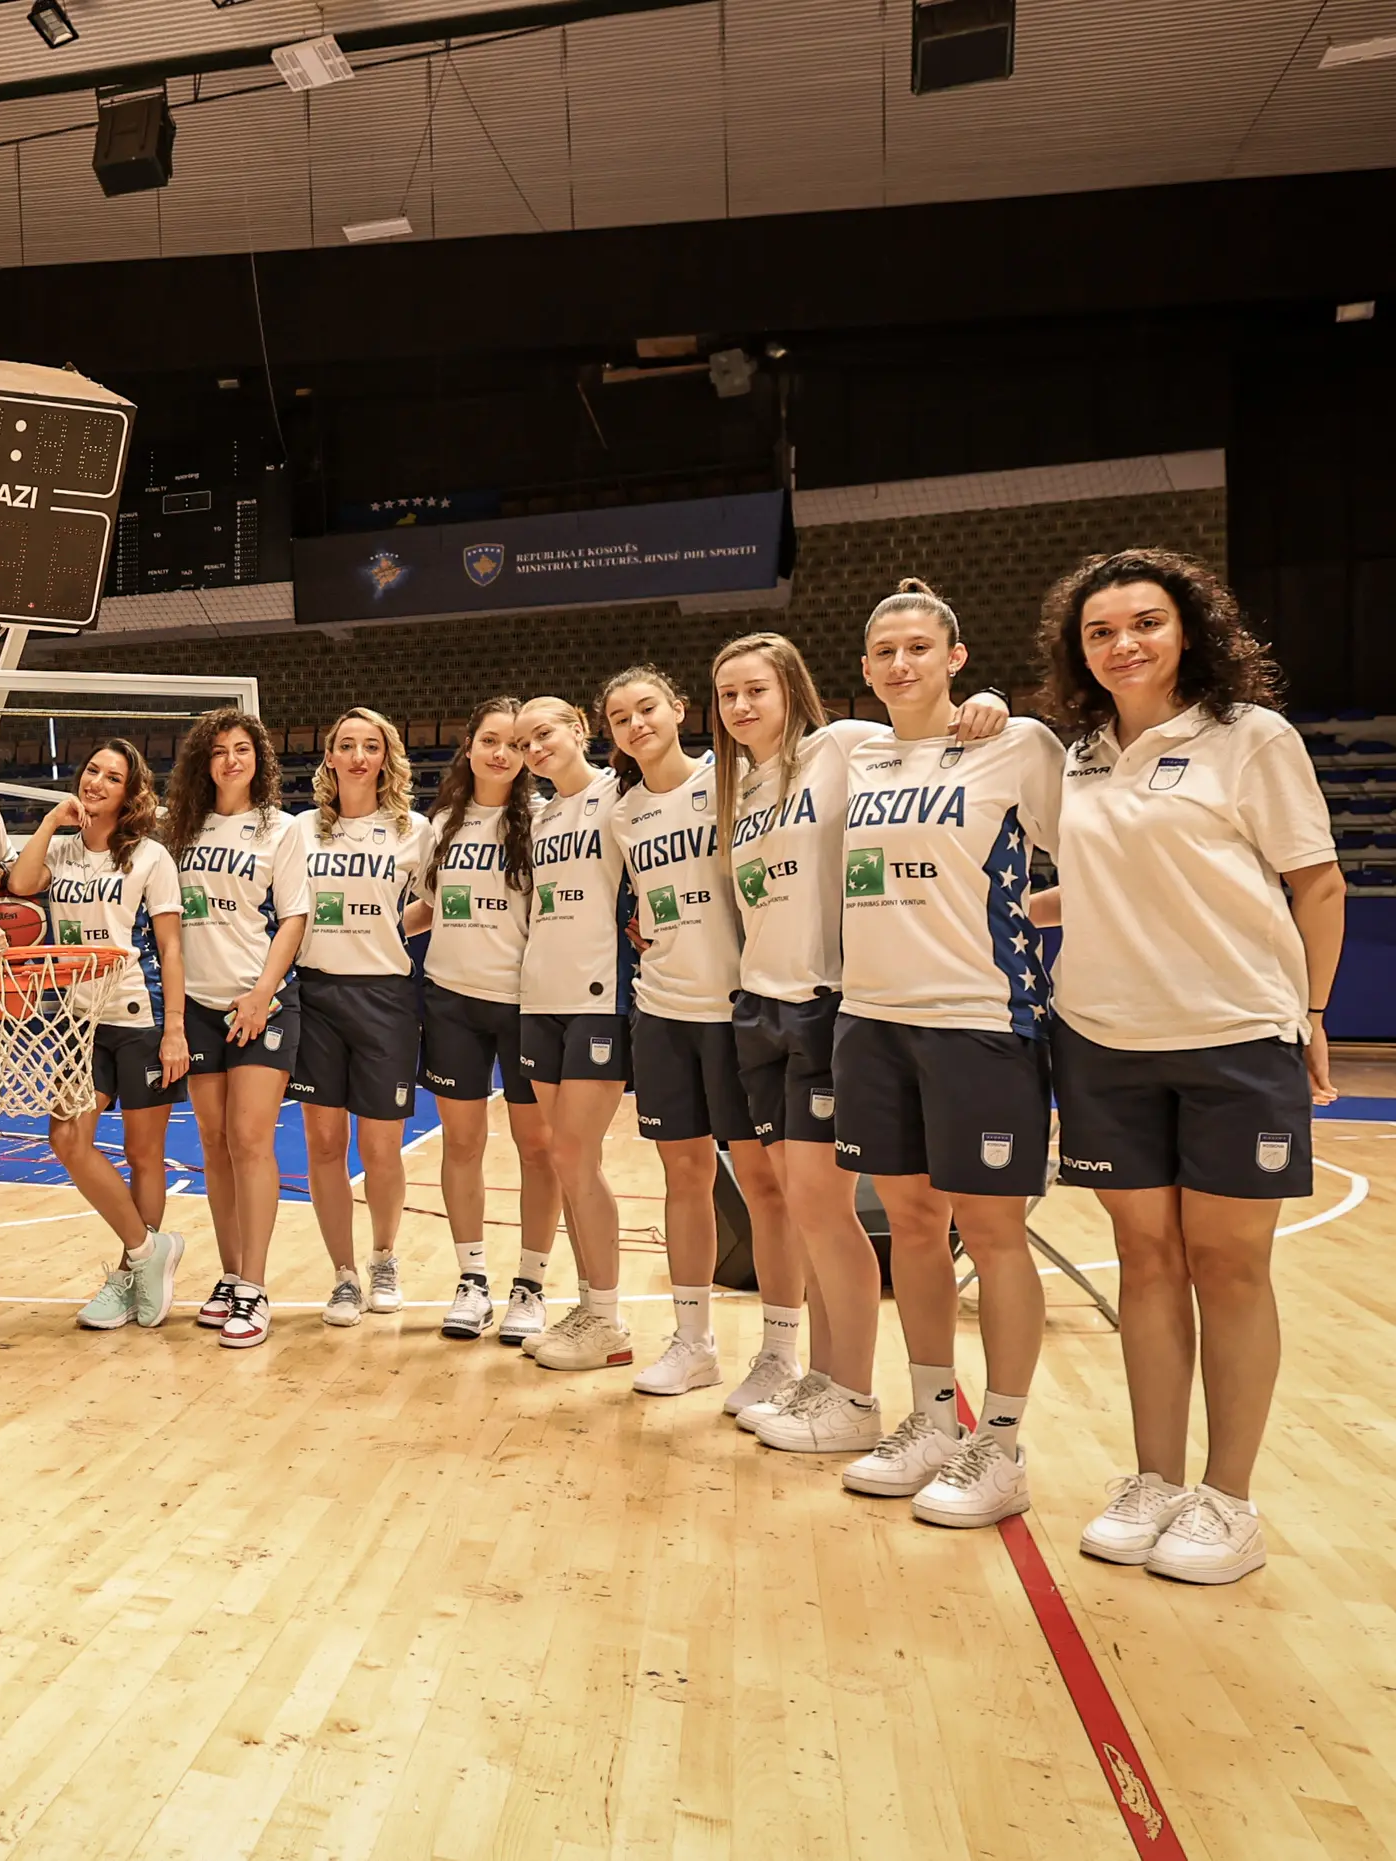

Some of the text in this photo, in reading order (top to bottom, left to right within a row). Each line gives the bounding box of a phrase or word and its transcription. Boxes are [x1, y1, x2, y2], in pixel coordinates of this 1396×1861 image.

[515, 543, 638, 563] REPUBLIKA E KOSOVËS
[515, 560, 572, 573] MINISTRIA
[574, 561, 581, 569] E
[683, 550, 708, 560] DHE
[866, 759, 902, 771] GIVOVA
[1066, 766, 1111, 777] GIVOVA
[631, 809, 662, 824] GIVOVA
[733, 787, 817, 848] OSOVA
[178, 846, 256, 882] OSOVA
[439, 843, 506, 871] OSOV
[889, 862, 938, 878] TEB
[557, 889, 584, 902] TEB
[680, 890, 711, 905] TEB
[208, 897, 237, 911] TEB
[347, 903, 382, 916] TEB
[474, 897, 508, 911] TEB
[857, 900, 880, 908] PARIBAS
[84, 929, 109, 940] TEB
[520, 1054, 535, 1068] OVA
[289, 1083, 315, 1094] VOVA
[639, 1115, 662, 1126] OVA
[754, 1122, 773, 1135] OVA
[835, 1140, 861, 1156] OVA
